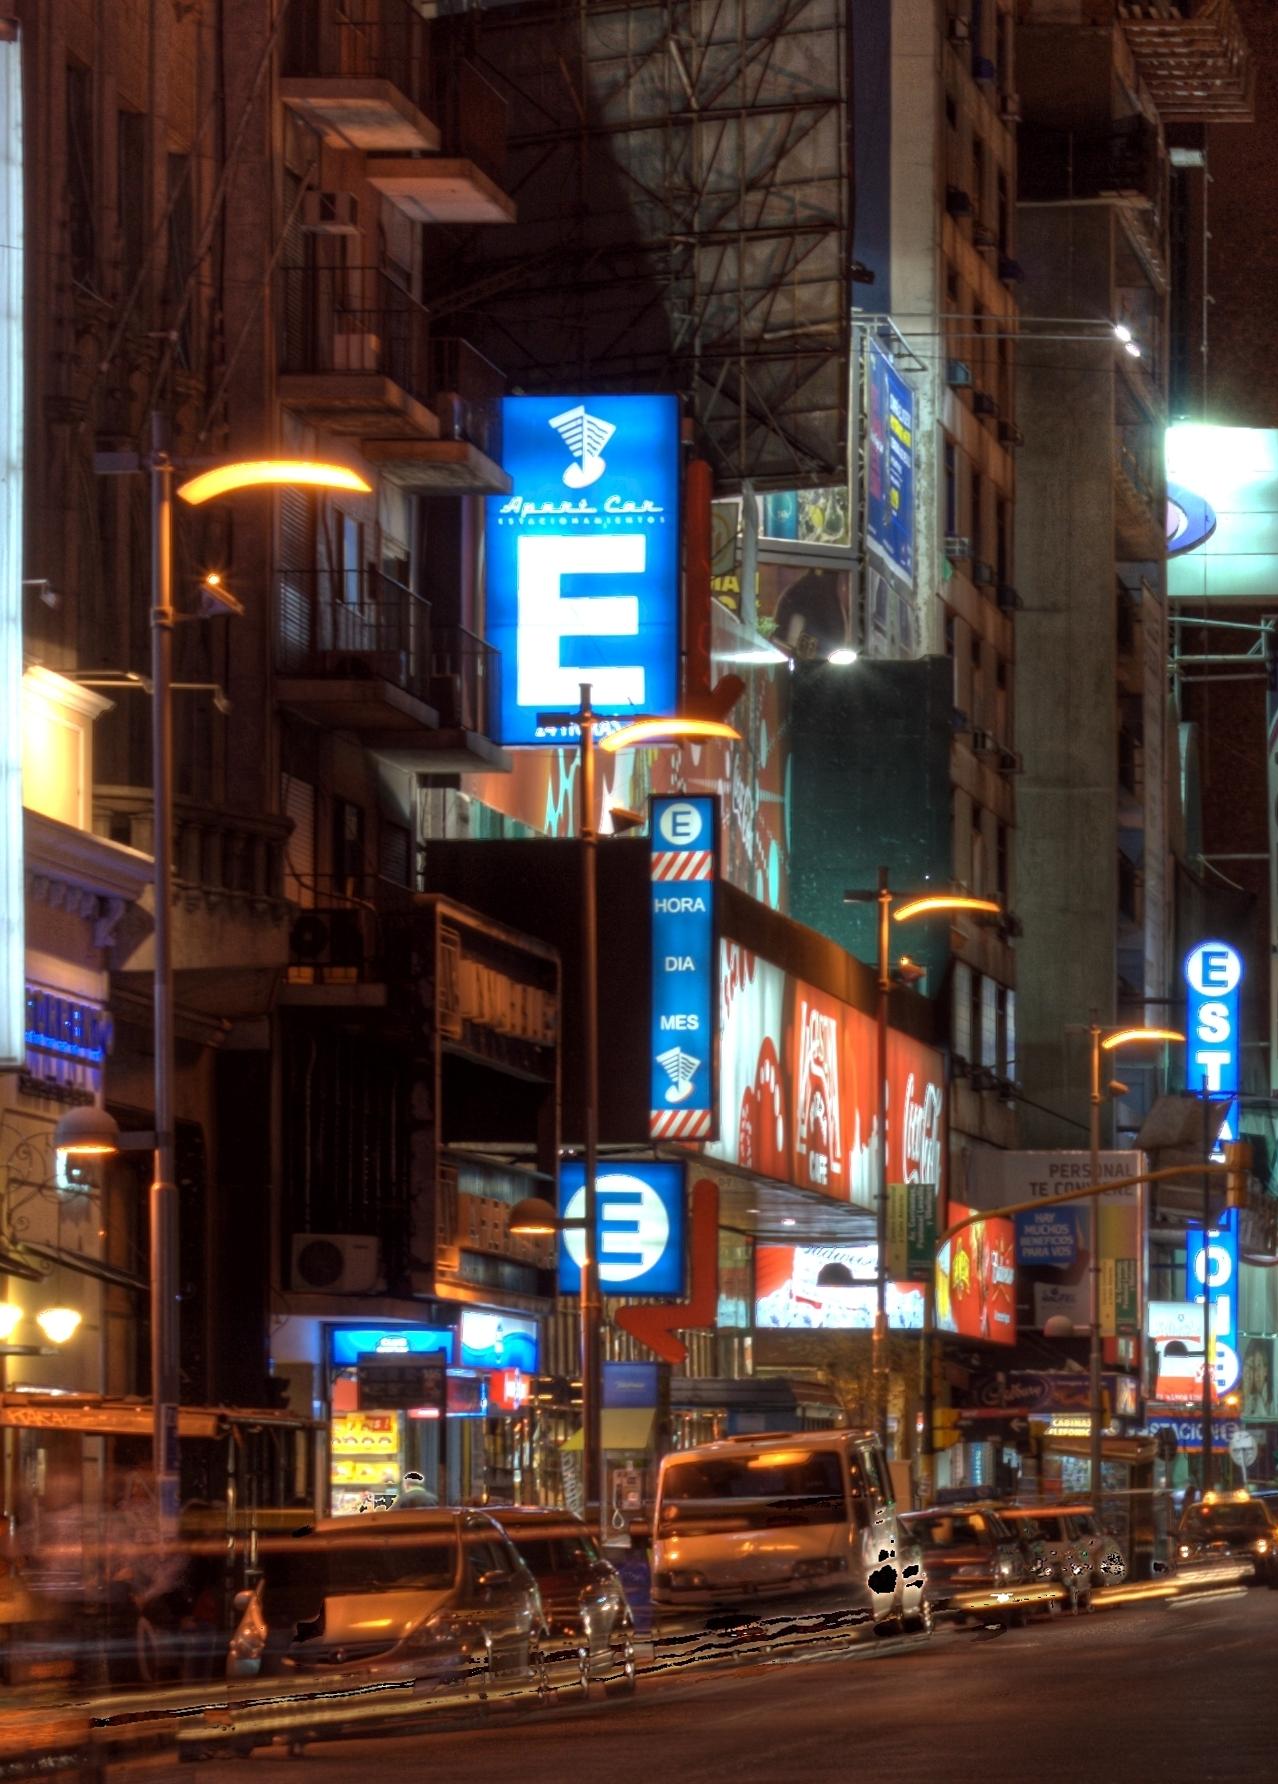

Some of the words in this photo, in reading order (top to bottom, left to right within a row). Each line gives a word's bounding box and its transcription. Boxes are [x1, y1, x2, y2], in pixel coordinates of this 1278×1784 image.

[500, 496, 598, 519] Apart
[604, 495, 664, 513] Car
[517, 534, 646, 706] E
[671, 810, 692, 837] E
[655, 897, 706, 914] HORA
[665, 956, 696, 972] DIA
[660, 1014, 700, 1031] MES
[1049, 1163, 1133, 1178] PERSNAL
[1029, 1182, 1049, 1197] TE
[600, 1192, 643, 1265] E
[1024, 1224, 1069, 1235] MUCHOS
[1022, 1247, 1049, 1257] PARA
[1051, 1247, 1072, 1257] VOS
